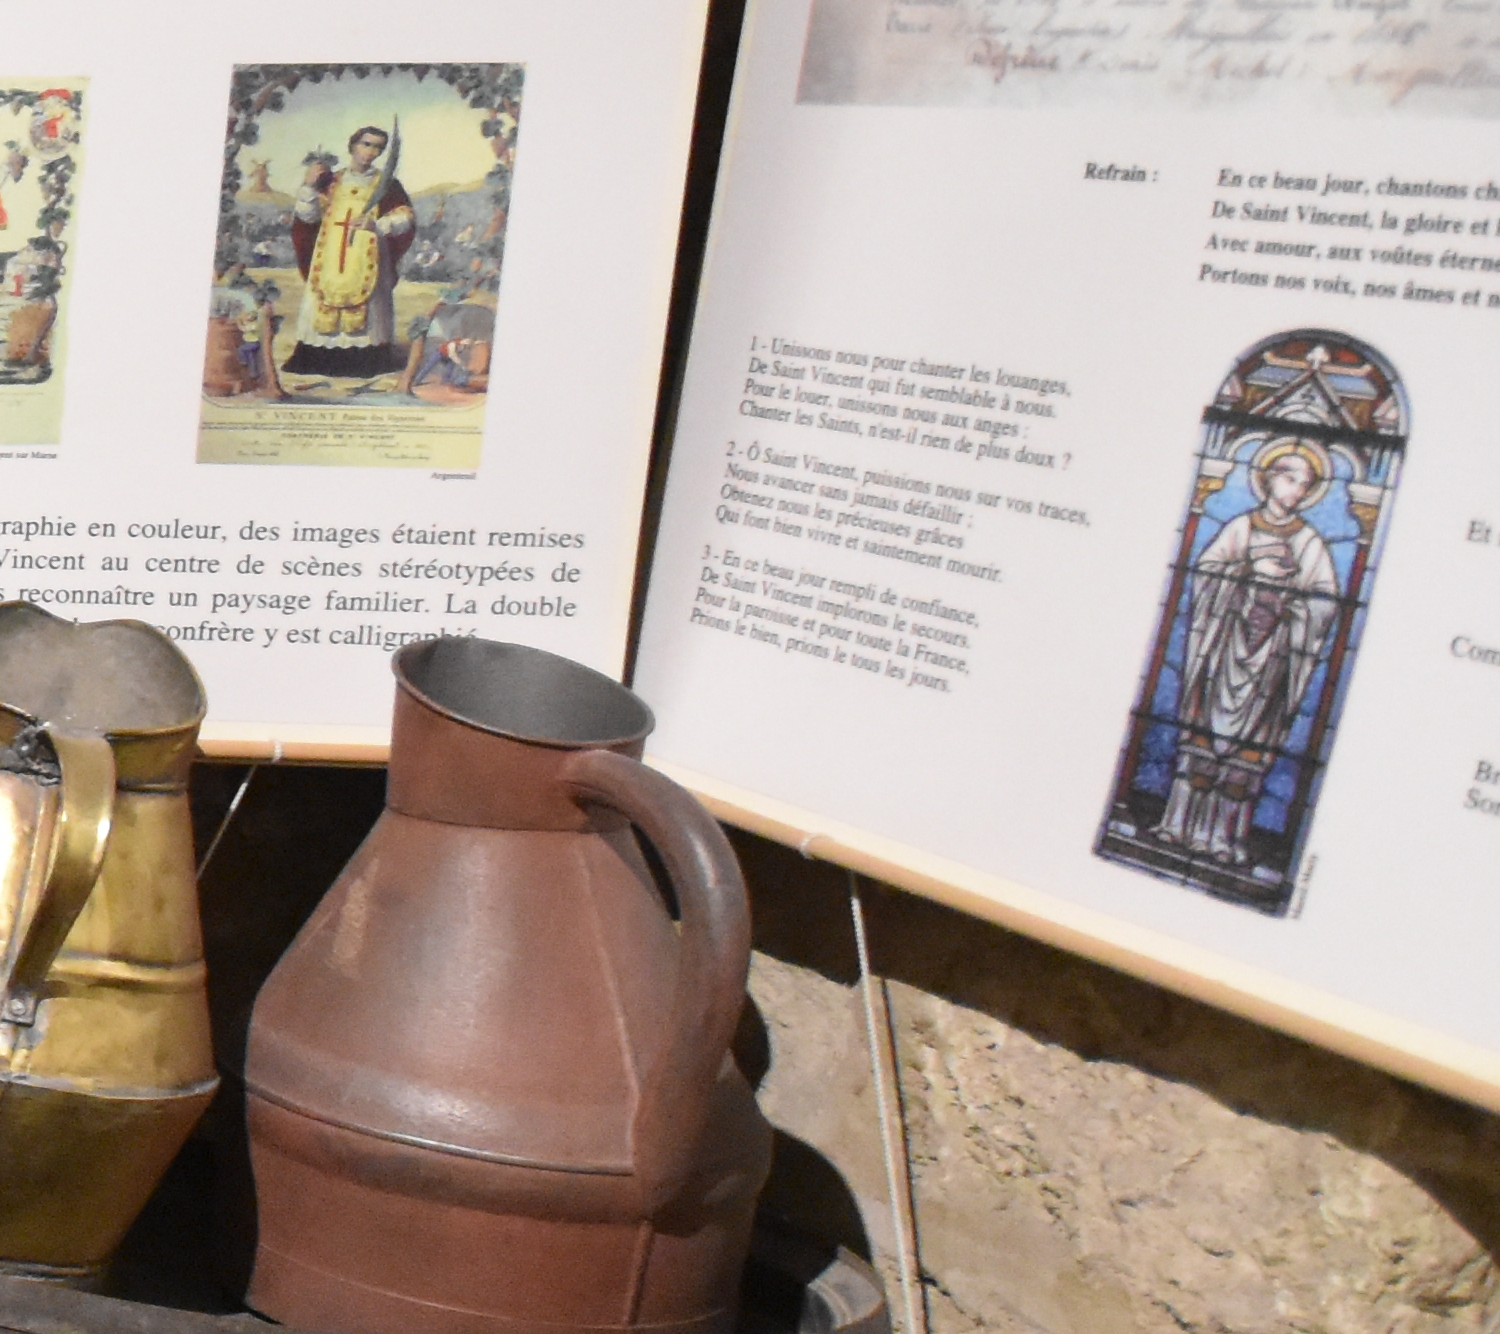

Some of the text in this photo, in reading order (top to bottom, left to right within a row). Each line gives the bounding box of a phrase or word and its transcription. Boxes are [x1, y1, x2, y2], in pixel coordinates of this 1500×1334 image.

[1083, 162, 1146, 182] Refrain
[1217, 168, 1468, 199] En ce beau jour, chantons
[1211, 200, 1489, 236] De Saint Vincent, la gloire et
[771, 360, 805, 381] Saint
[810, 365, 864, 390] Vincent
[867, 376, 890, 396] qui
[920, 384, 996, 411] semblable
